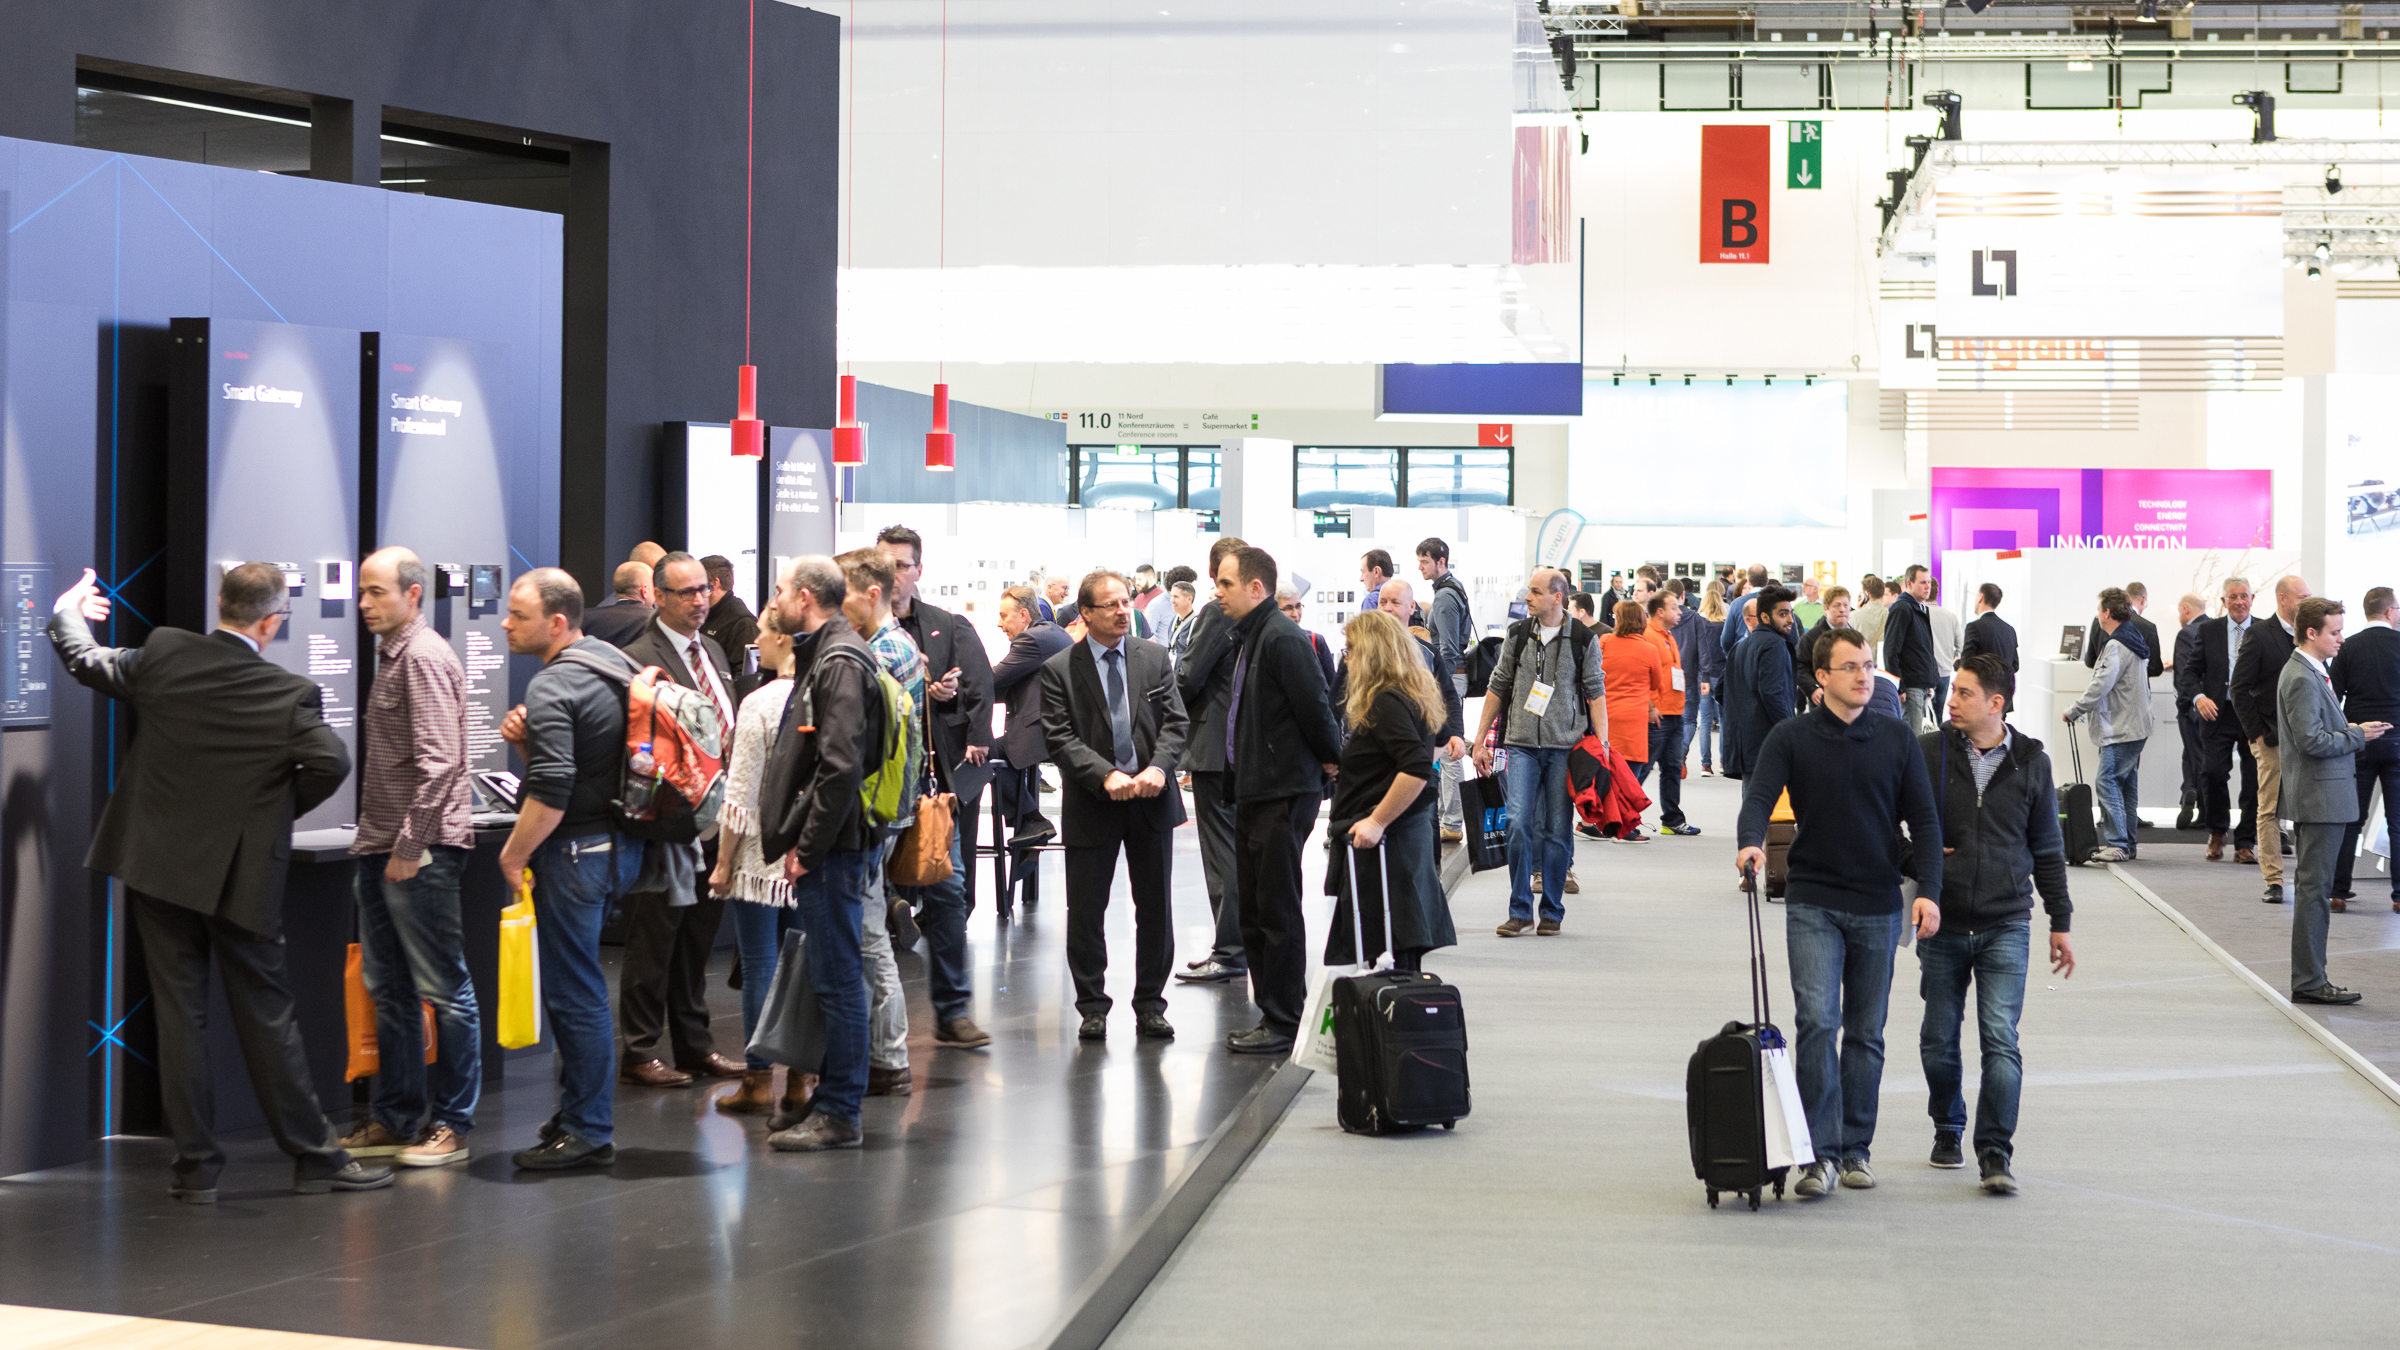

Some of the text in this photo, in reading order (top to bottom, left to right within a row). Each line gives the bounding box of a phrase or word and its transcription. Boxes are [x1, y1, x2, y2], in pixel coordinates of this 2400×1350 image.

[1722, 199, 1758, 248] B
[1720, 252, 1750, 260] Halle 11.1
[222, 382, 304, 409] Smart Gateway
[391, 392, 463, 418] Smart Gateway
[391, 416, 447, 436] Professional
[1079, 412, 1112, 429] 11.0
[1202, 422, 1248, 431] Supermarket
[2138, 500, 2187, 509] TECHNOLOGY
[2157, 511, 2187, 520] ENERGY
[2134, 523, 2187, 532] CONNECTIVITY
[2050, 534, 2187, 550] INNOVATION
